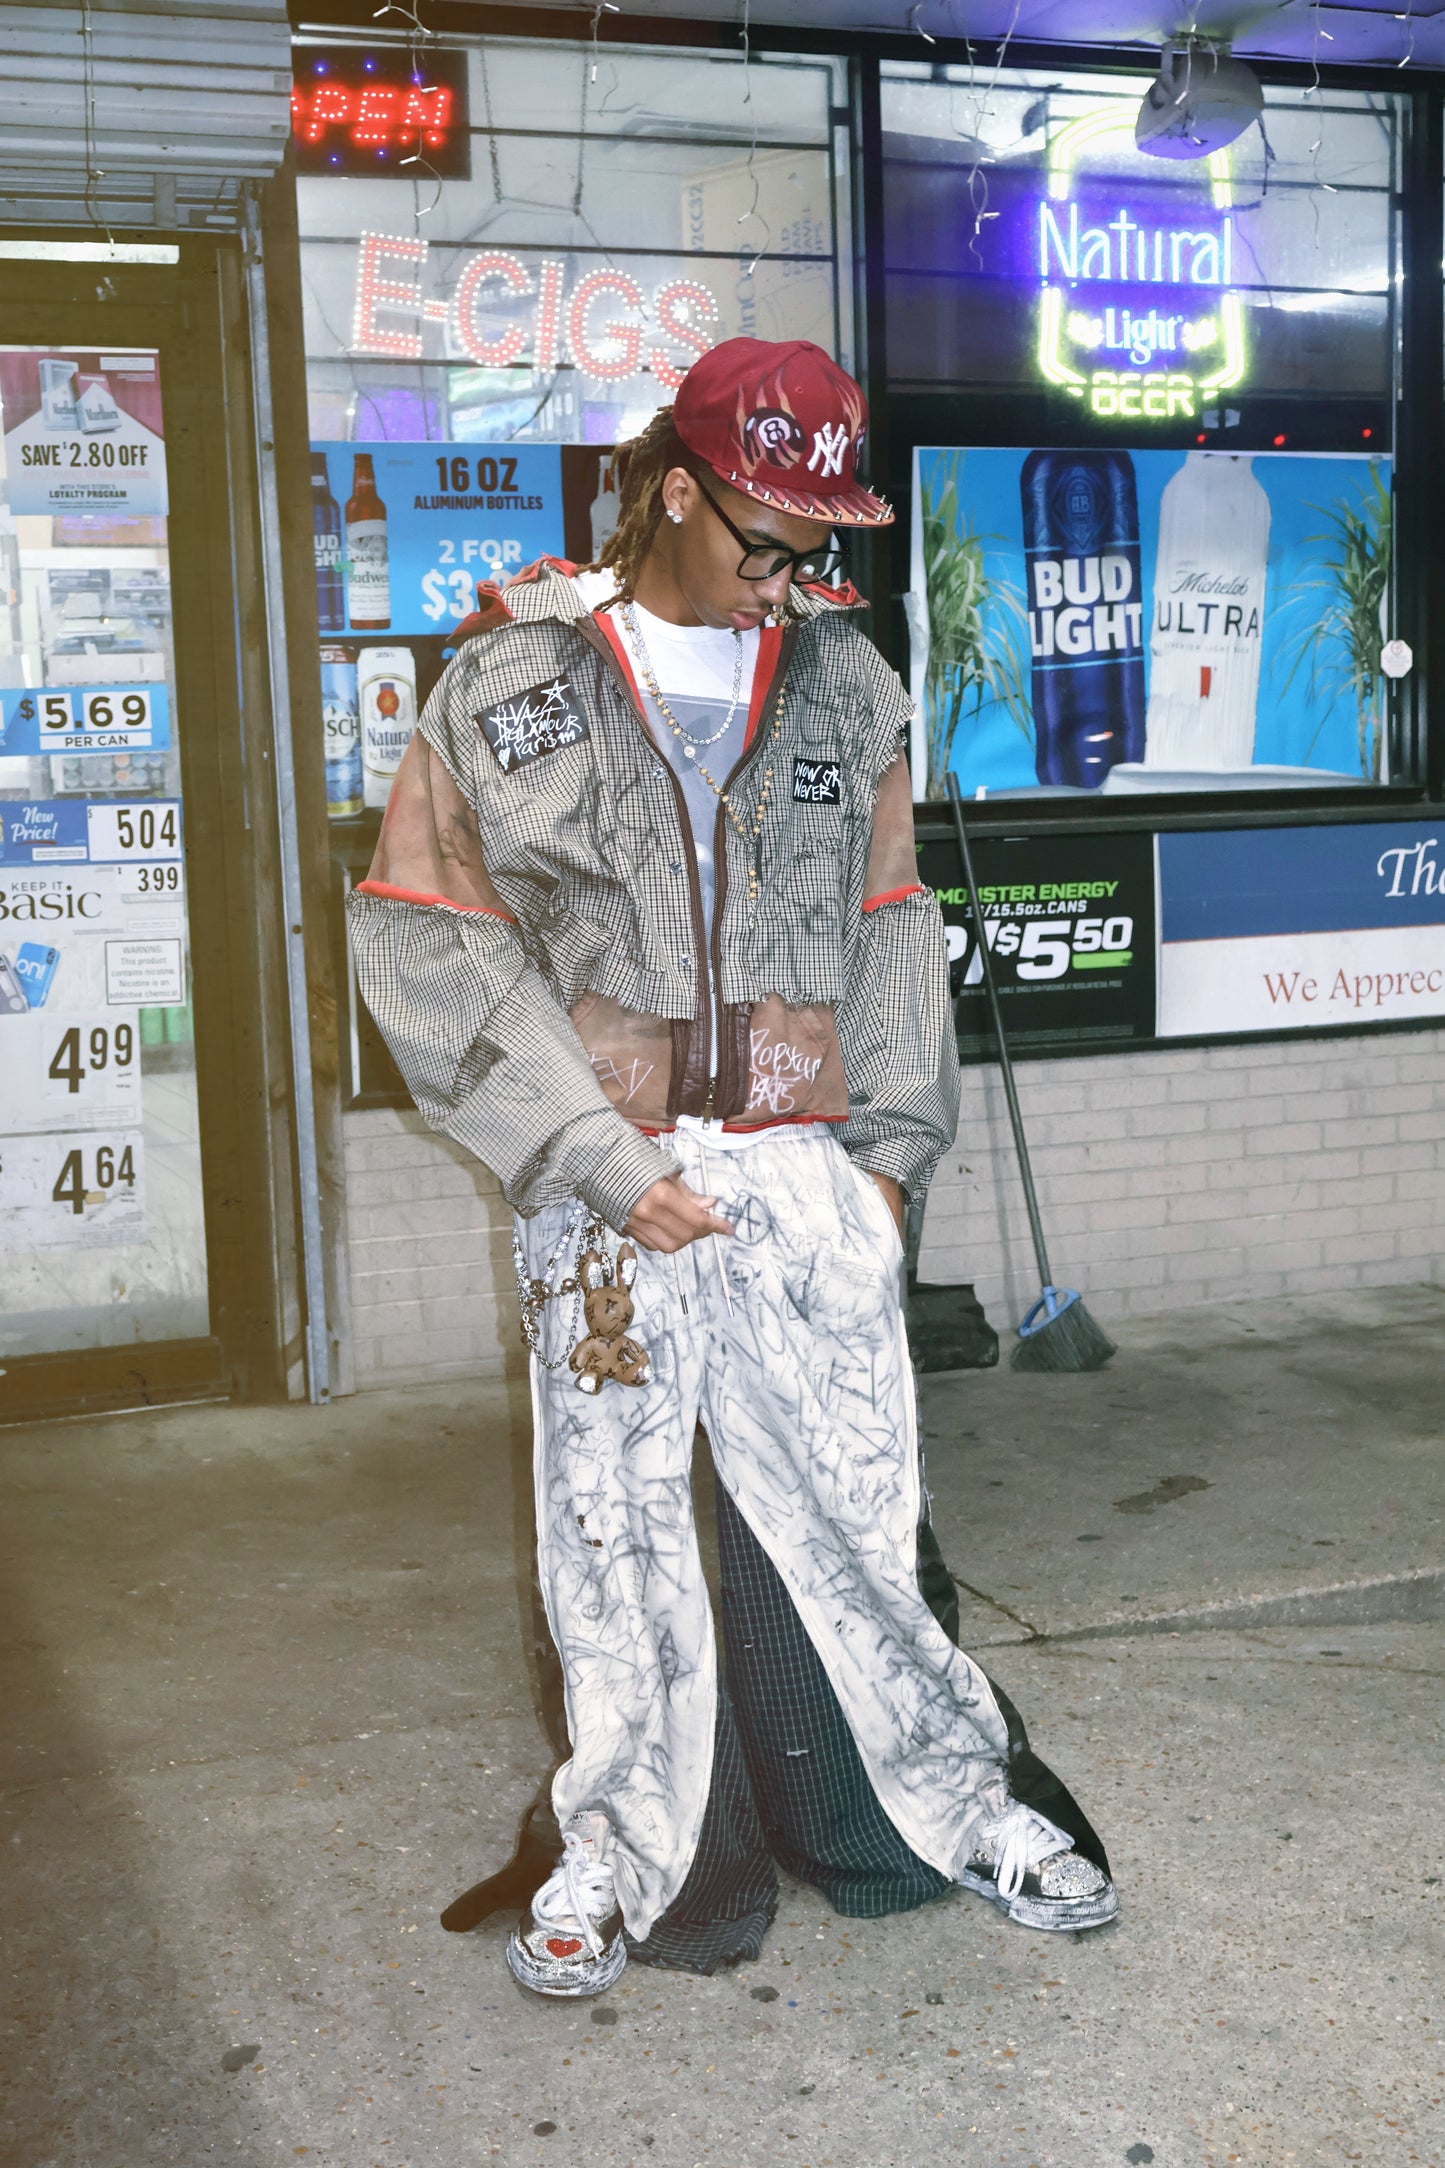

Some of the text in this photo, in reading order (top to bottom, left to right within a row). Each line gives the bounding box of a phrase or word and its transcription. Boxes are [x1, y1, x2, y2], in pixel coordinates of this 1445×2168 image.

[1040, 201, 1232, 287] Natural
[352, 230, 719, 391] E-CIGS
[1105, 307, 1184, 366] Light
[1091, 372, 1195, 417] BEER
[21, 444, 61, 466] SAVE
[119, 444, 148, 466] OFF
[436, 456, 518, 492] 16 OZ
[49, 490, 127, 498] LOYALTY PROGRAM
[414, 495, 543, 510] ALUMINUM BOTTLES
[313, 533, 339, 550] UD
[438, 539, 522, 564] 2 FOR
[1033, 555, 1133, 608] BUD
[1168, 569, 1250, 597] Michelob
[1029, 602, 1143, 657] LIGHT
[1158, 599, 1259, 638] ULTRA
[19, 695, 146, 730] $5.69
[65, 734, 129, 747] PER CAN
[22, 806, 54, 825] New
[117, 808, 176, 849] 504
[10, 822, 59, 842] Price!
[11, 881, 63, 892] KEEP IT
[937, 881, 1119, 905] MOSTER ENERGY
[1263, 972, 1319, 1004] We
